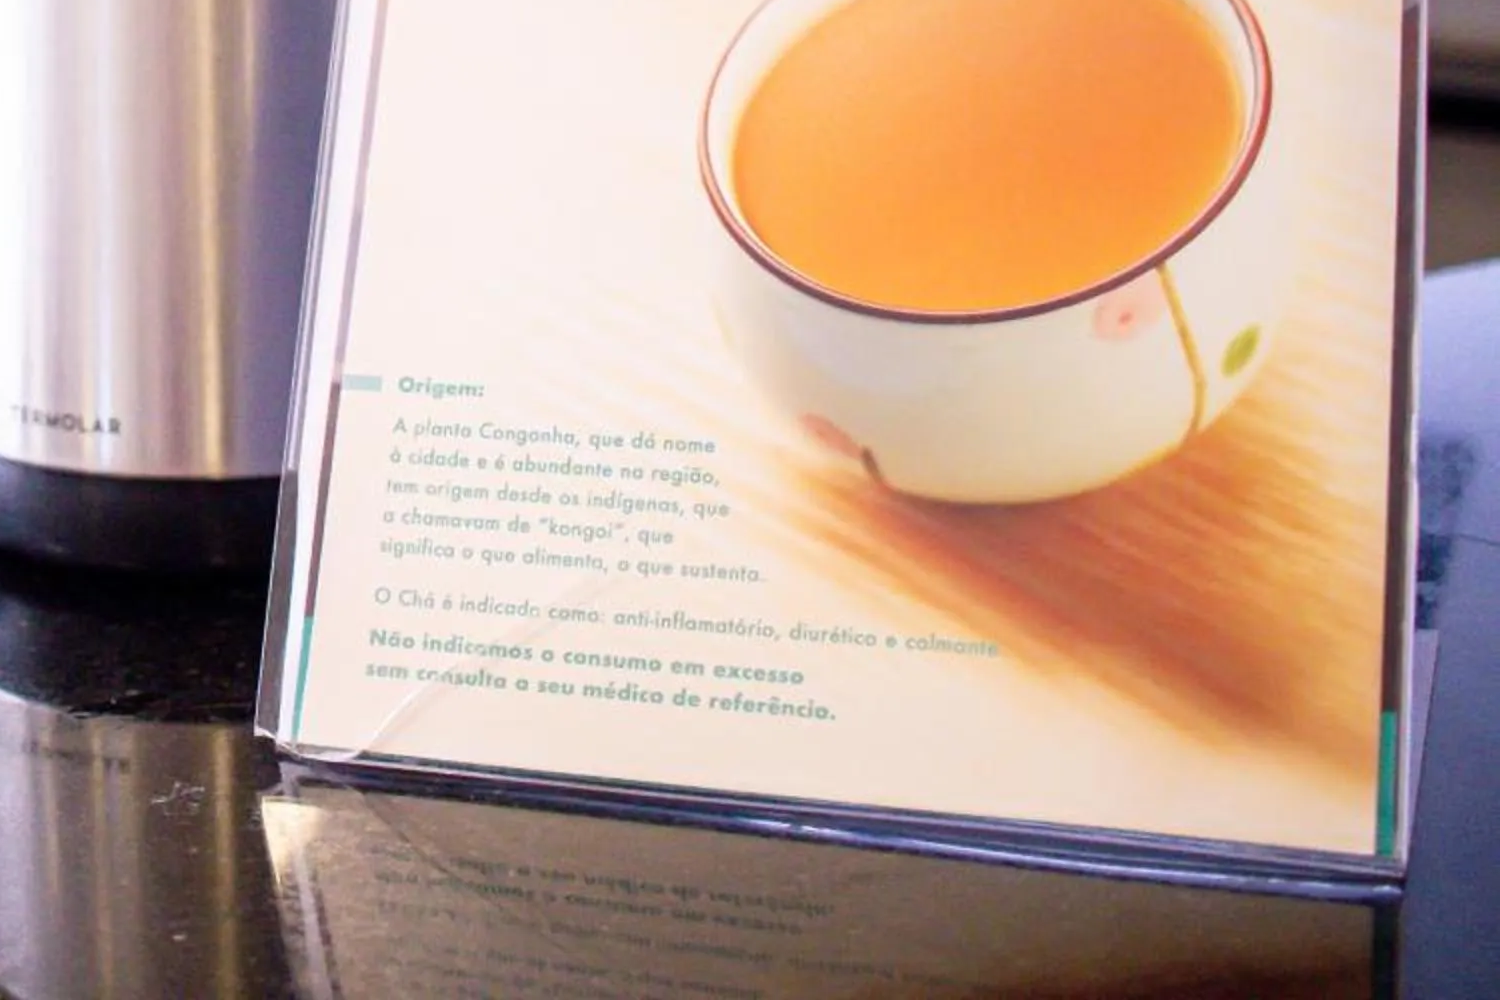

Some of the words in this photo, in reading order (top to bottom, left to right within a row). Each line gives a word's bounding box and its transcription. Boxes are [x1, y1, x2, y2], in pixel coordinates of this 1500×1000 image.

[398, 376, 485, 399] Origem:
[392, 417, 407, 434] A
[413, 416, 472, 440] planta
[479, 422, 581, 447] Congonha,
[589, 434, 624, 450] que
[631, 432, 655, 450] dá
[663, 438, 716, 453] nome
[408, 448, 470, 469] cidade
[477, 457, 488, 469] e
[494, 454, 505, 471] é
[513, 454, 613, 478] abundante
[620, 467, 644, 480] na
[651, 467, 720, 487] região,
[387, 479, 419, 494] tem
[425, 481, 489, 502] origem
[497, 482, 552, 505] desde
[559, 493, 580, 506] os
[587, 490, 686, 516] indígenas,
[693, 502, 730, 520] que
[402, 507, 500, 532] chamavam
[507, 515, 531, 533] de
[637, 529, 674, 546] que
[380, 537, 455, 559] significa
[481, 549, 516, 566] que
[522, 547, 608, 575] alimenta,
[636, 560, 674, 578] que
[374, 587, 391, 604] O
[399, 589, 435, 609] Chá
[442, 595, 453, 610] é
[459, 594, 541, 617] indicado
[614, 609, 781, 641] anti-inflamatório,
[789, 622, 877, 646] diurético
[886, 634, 898, 648] e
[905, 633, 999, 657] calmante
[370, 629, 415, 648] Não
[422, 632, 533, 660] indicamos
[541, 649, 554, 662] o
[563, 650, 661, 672] consumo
[670, 660, 704, 675] em
[713, 664, 805, 685] excesso
[365, 663, 408, 680] sem
[537, 680, 575, 696] seu
[583, 682, 664, 704] médico
[672, 688, 700, 707] de
[709, 692, 836, 720] referência.
